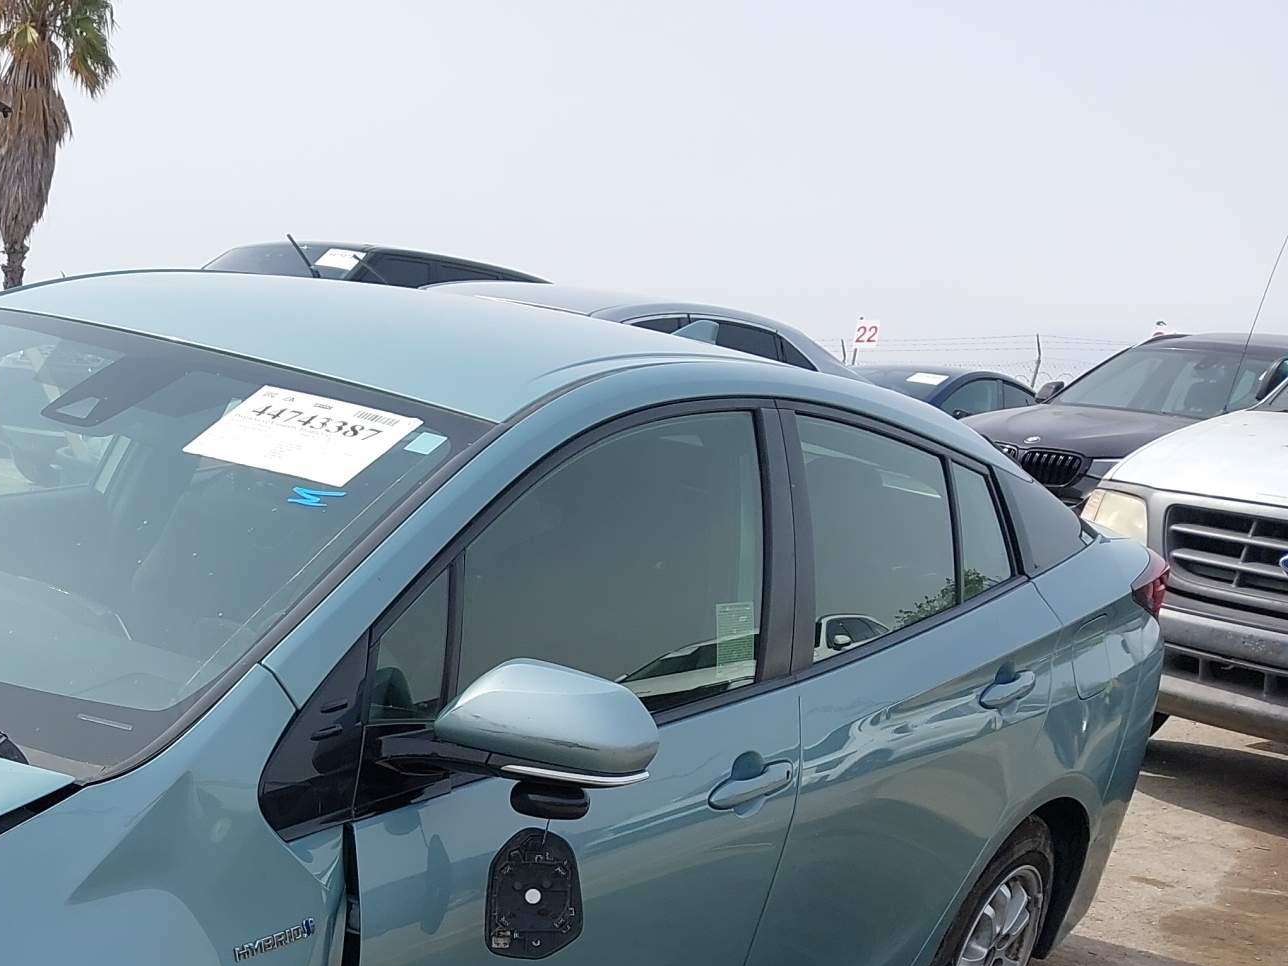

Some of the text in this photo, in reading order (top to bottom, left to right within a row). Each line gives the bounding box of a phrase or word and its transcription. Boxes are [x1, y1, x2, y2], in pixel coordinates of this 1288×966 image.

[855, 325, 878, 343] 22
[251, 404, 383, 441] 44743387
[233, 925, 303, 963] HYBRID
